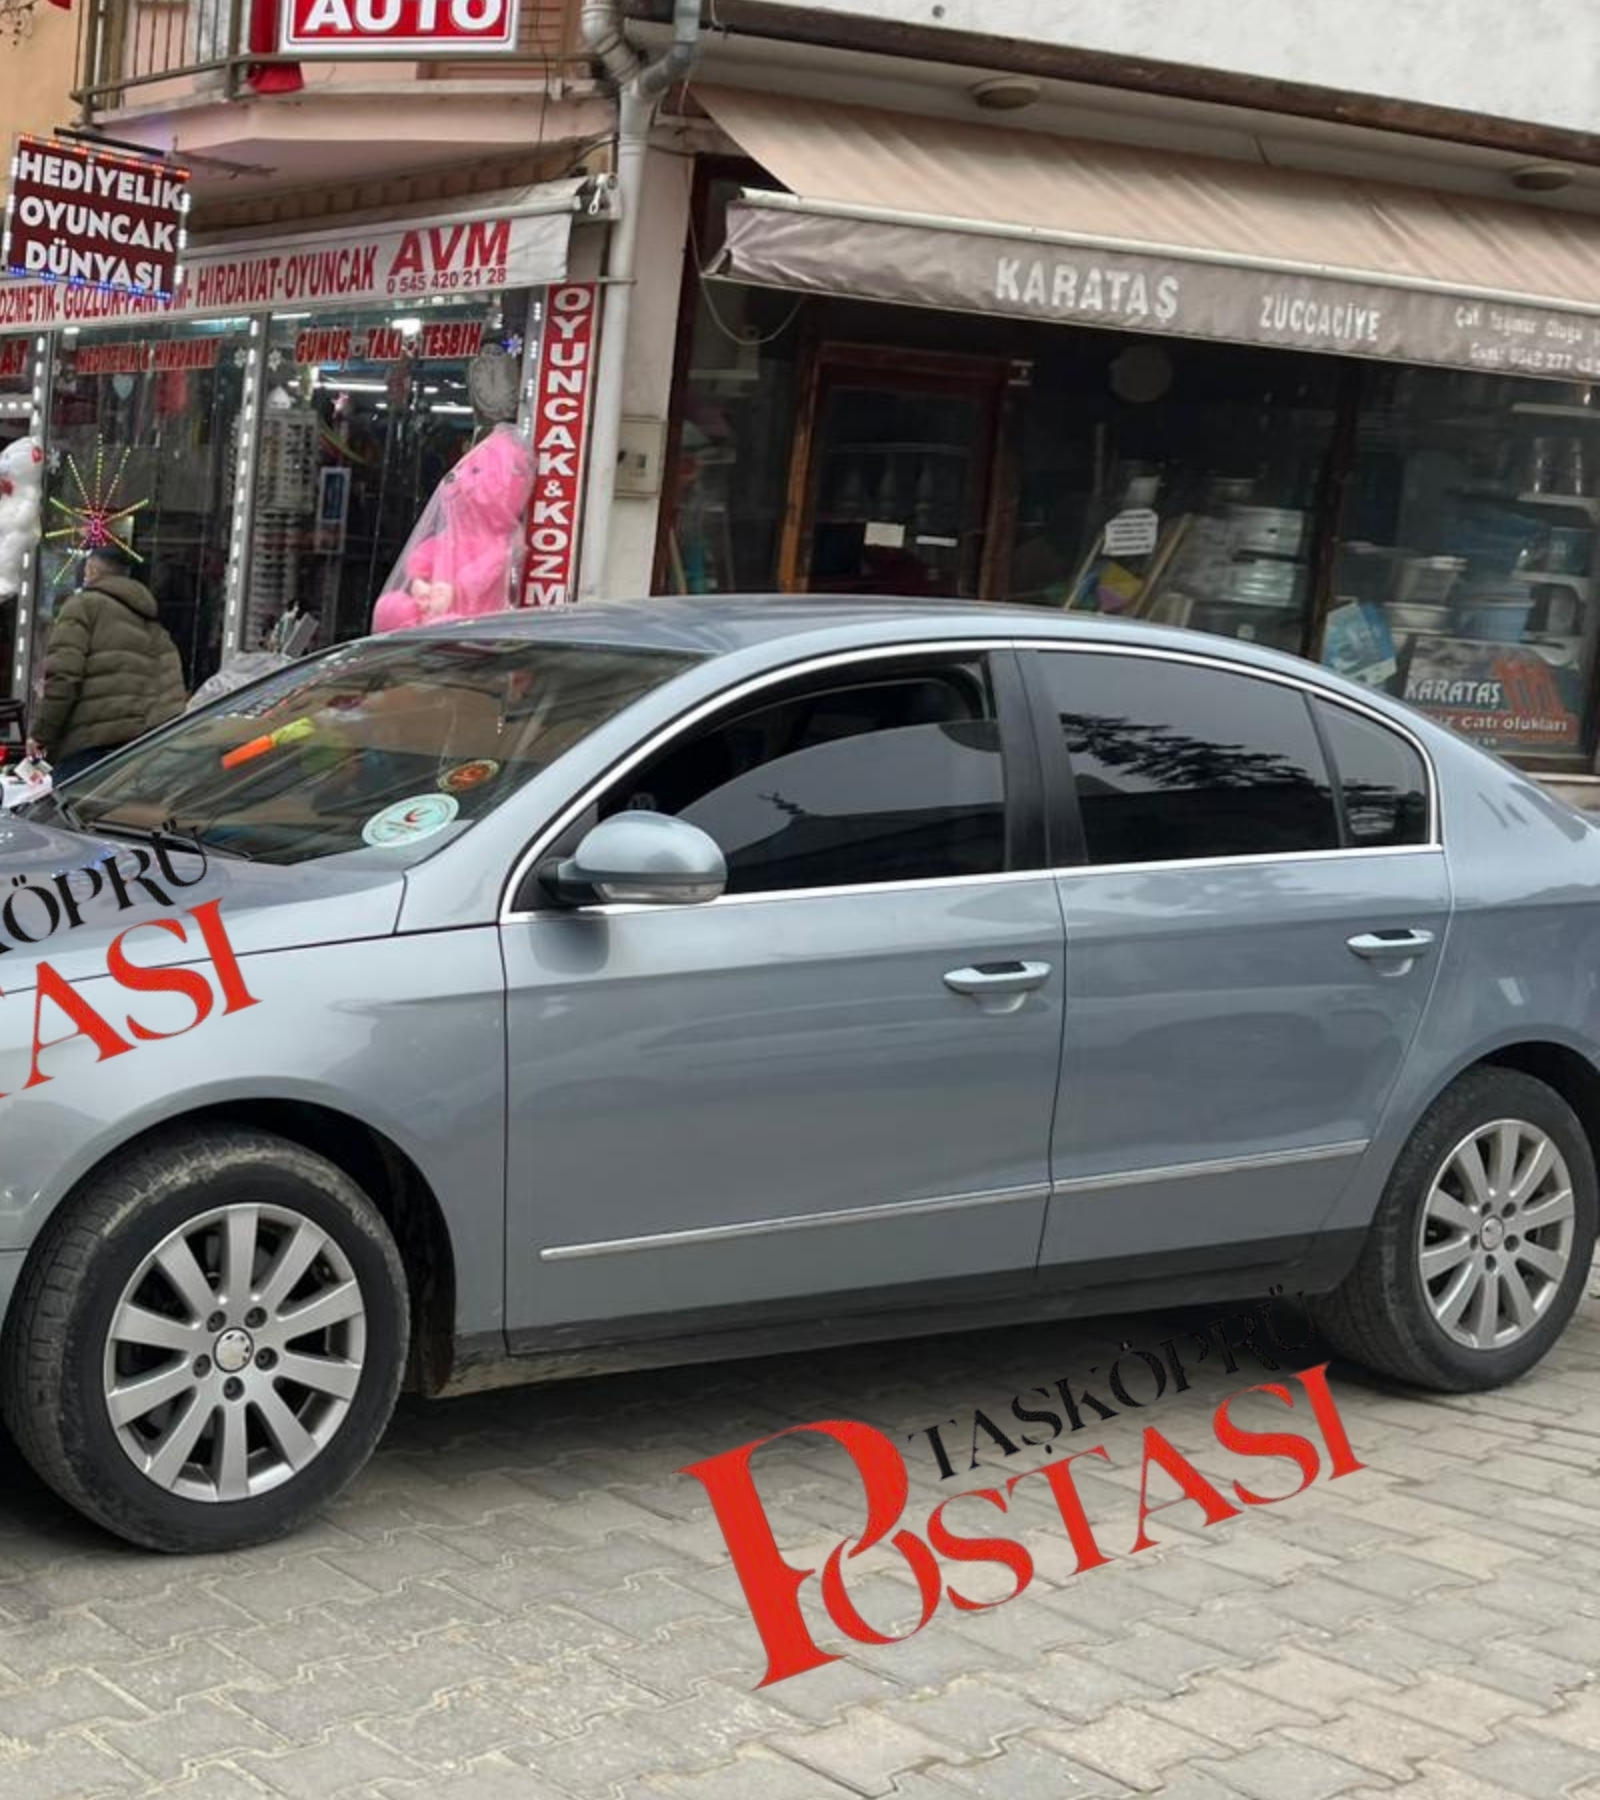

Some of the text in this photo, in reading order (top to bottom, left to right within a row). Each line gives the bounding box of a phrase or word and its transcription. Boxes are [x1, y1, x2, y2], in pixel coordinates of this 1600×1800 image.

[19, 151, 185, 211] HEDİYELİK
[19, 196, 177, 252] OYUNCAK
[389, 219, 512, 276] AVM
[25, 237, 163, 293] DÜNYASI
[399, 273, 427, 294] 545
[431, 270, 460, 290] 420
[464, 269, 481, 287] 21
[995, 256, 1180, 323] KARATAŞ
[1403, 678, 1502, 709] KARATAŞ
